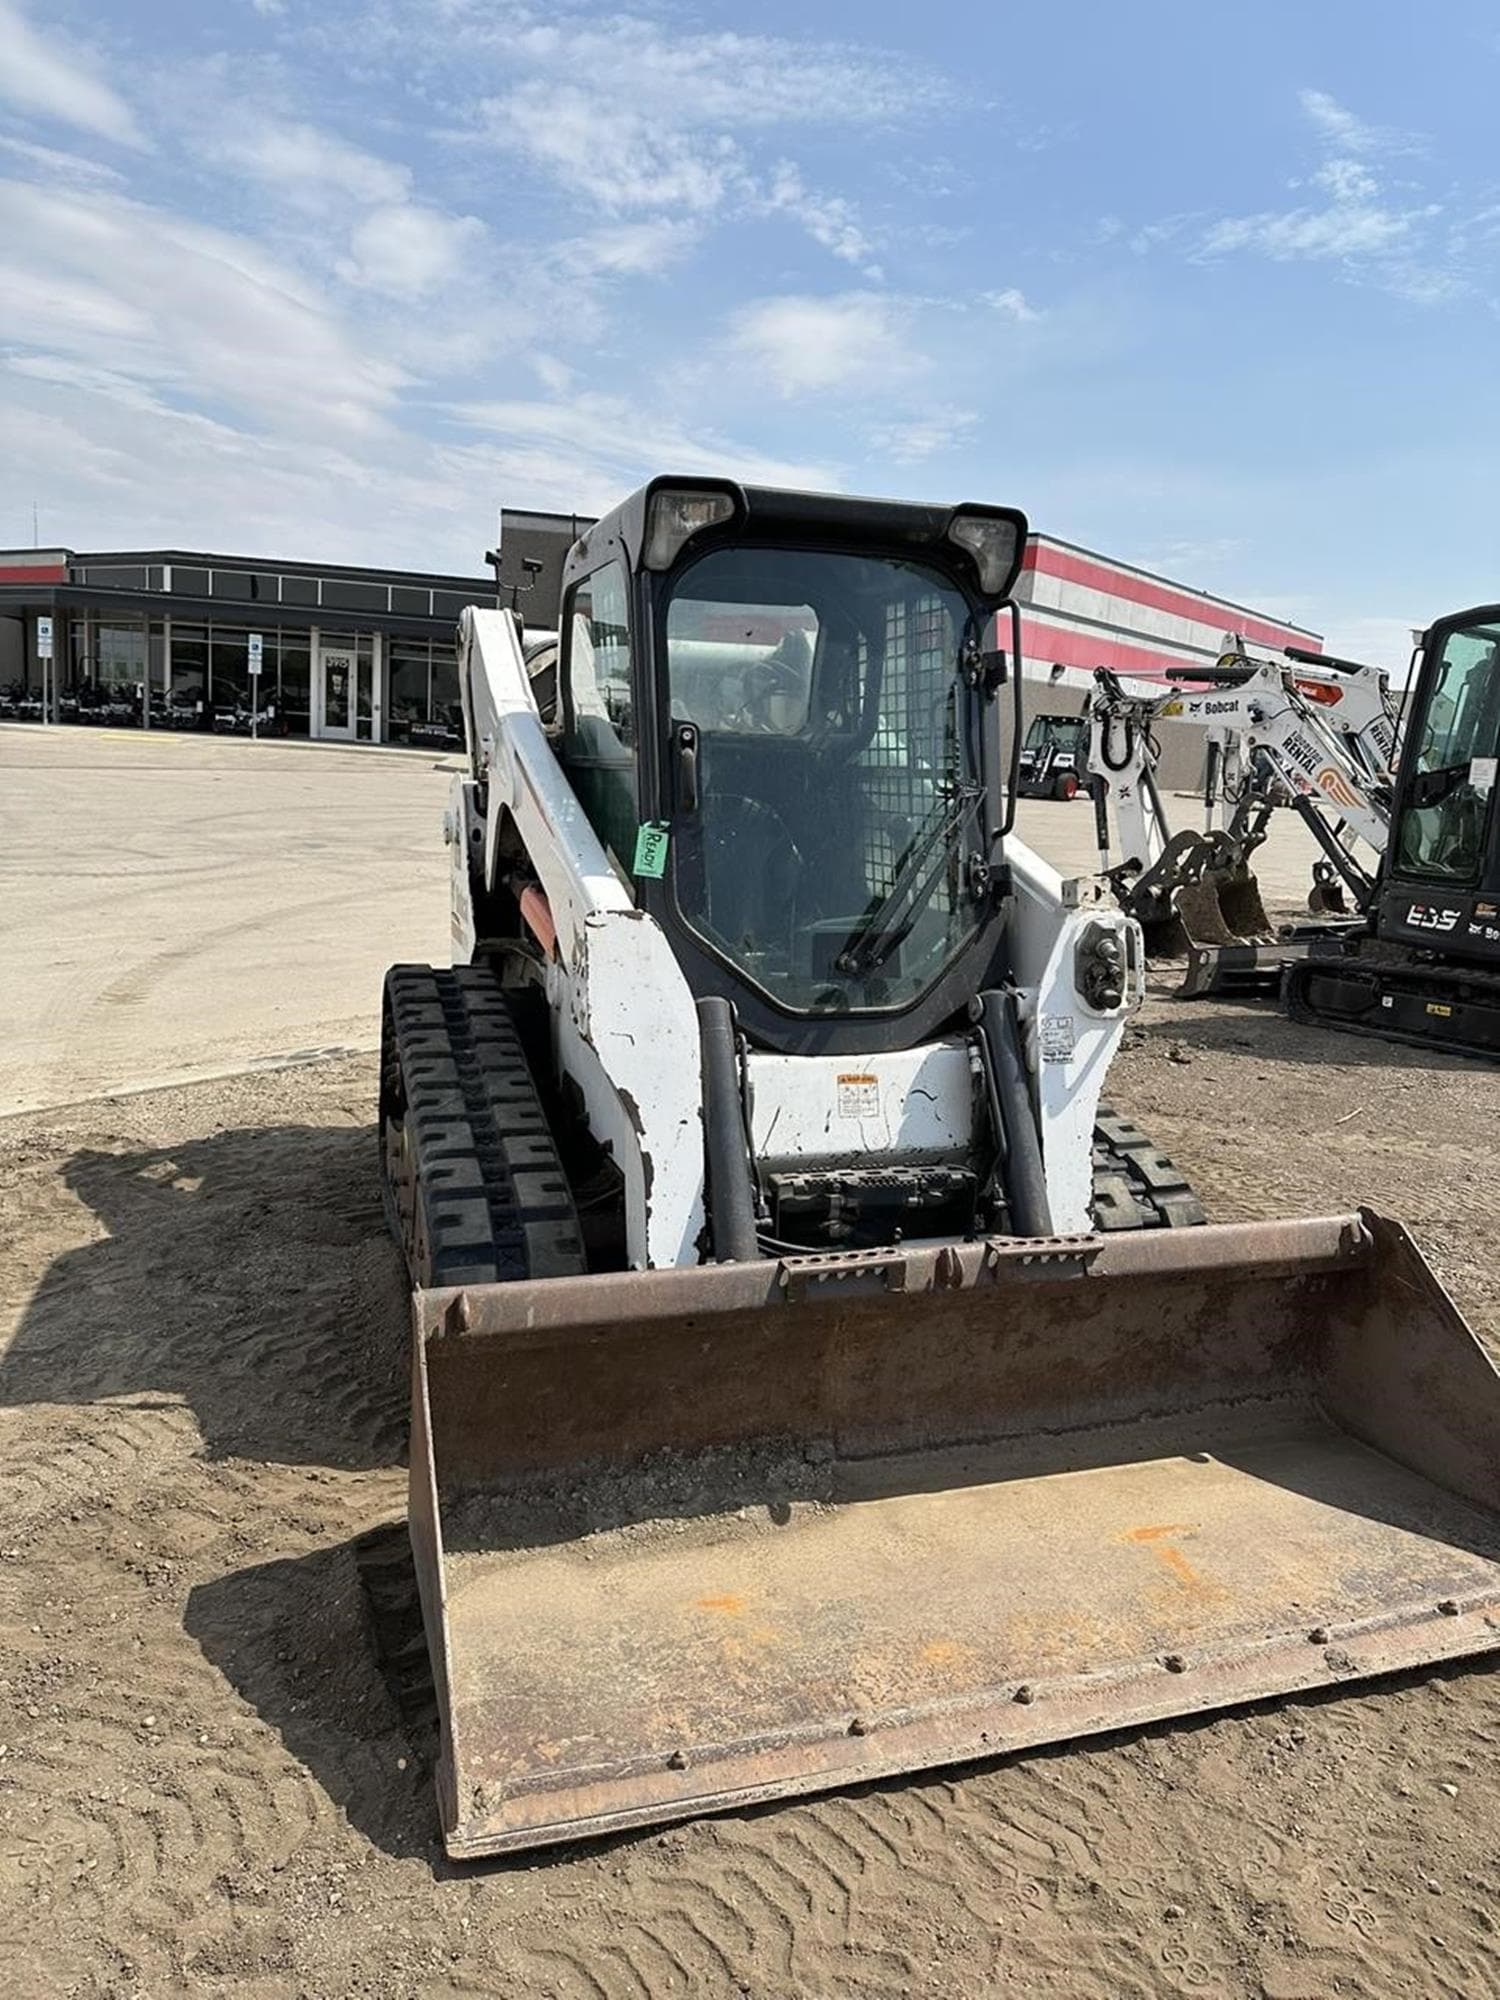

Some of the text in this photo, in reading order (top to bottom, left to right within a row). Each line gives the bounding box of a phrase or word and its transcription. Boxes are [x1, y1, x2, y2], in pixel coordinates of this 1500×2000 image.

[1205, 699, 1239, 715] Bobcat
[1282, 736, 1316, 775] RENTAL
[644, 833, 662, 868] READY
